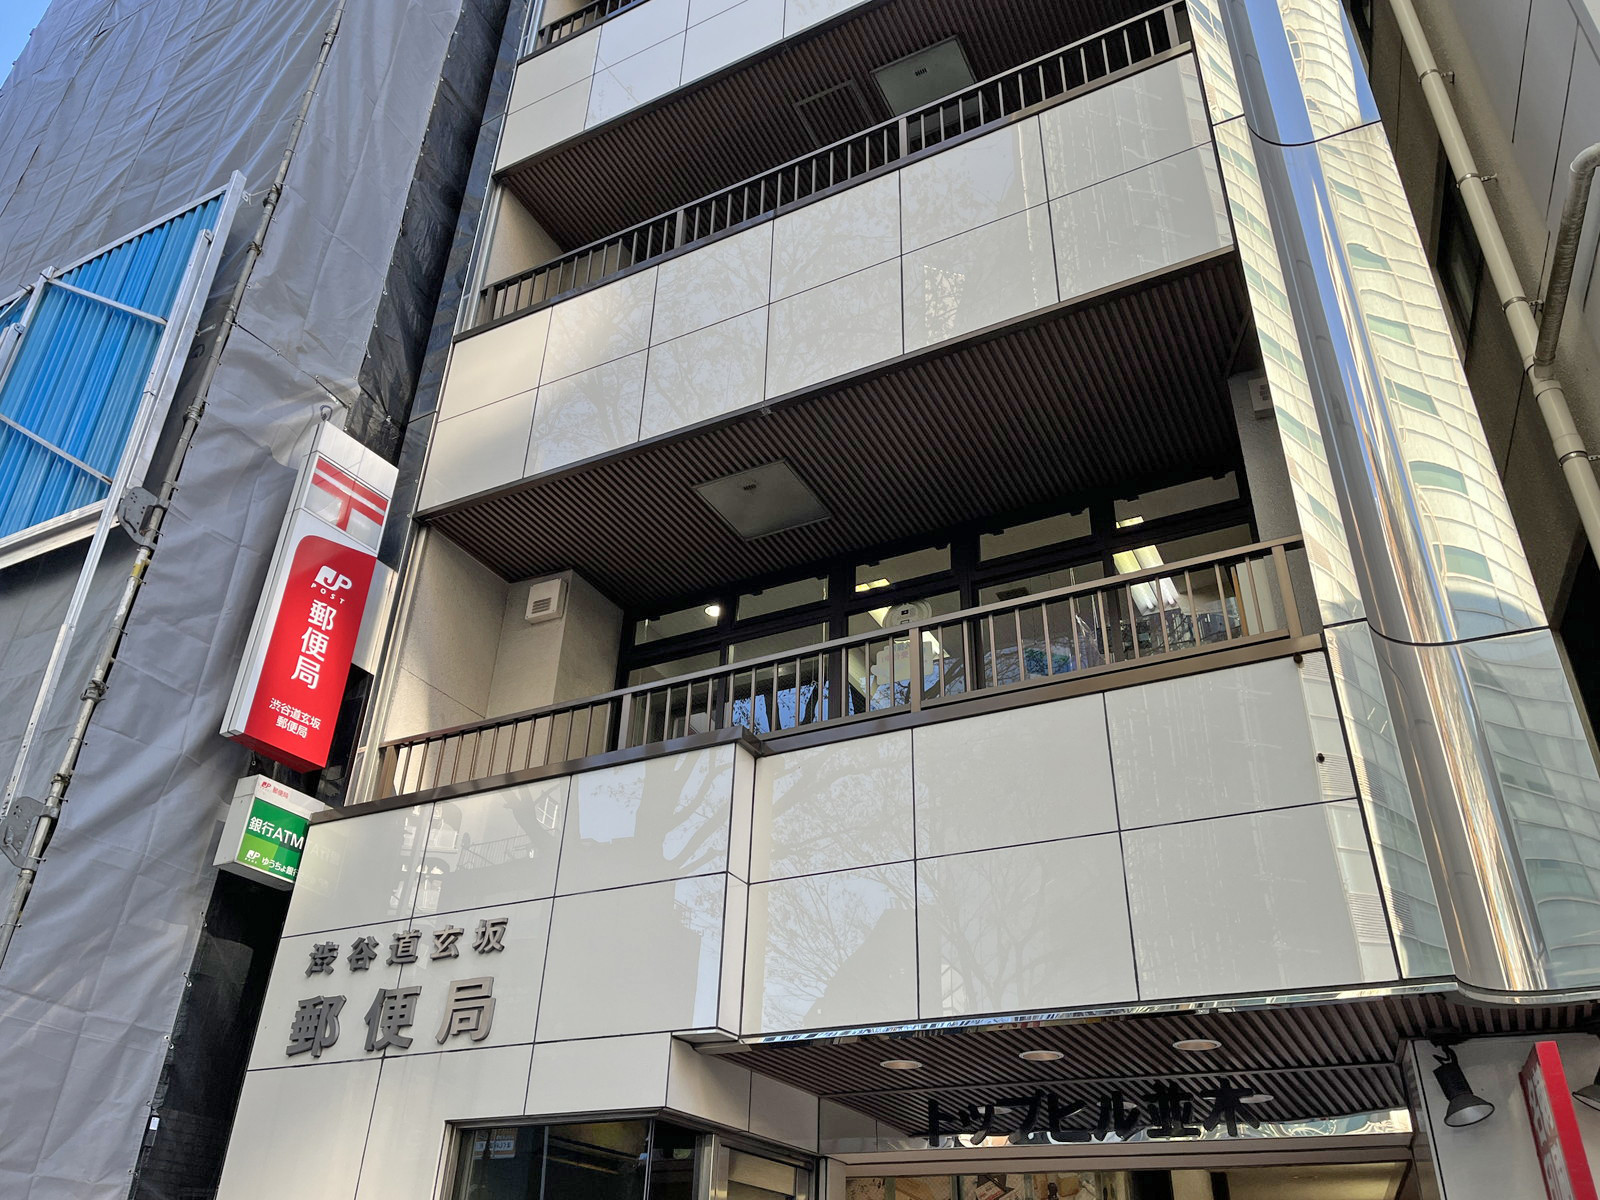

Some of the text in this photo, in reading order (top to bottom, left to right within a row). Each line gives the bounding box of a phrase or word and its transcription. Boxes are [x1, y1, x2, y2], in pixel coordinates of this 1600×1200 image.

[310, 582, 346, 604] POST
[291, 599, 337, 690] 郵便局
[268, 697, 322, 730] 渋谷道玄坂
[275, 715, 308, 739] 郵便局
[248, 816, 305, 850] 銀行ATM
[304, 917, 509, 978] 渋谷道玄坂
[285, 976, 497, 1058] 郵便局
[927, 1077, 1261, 1148] トップヒル並木
